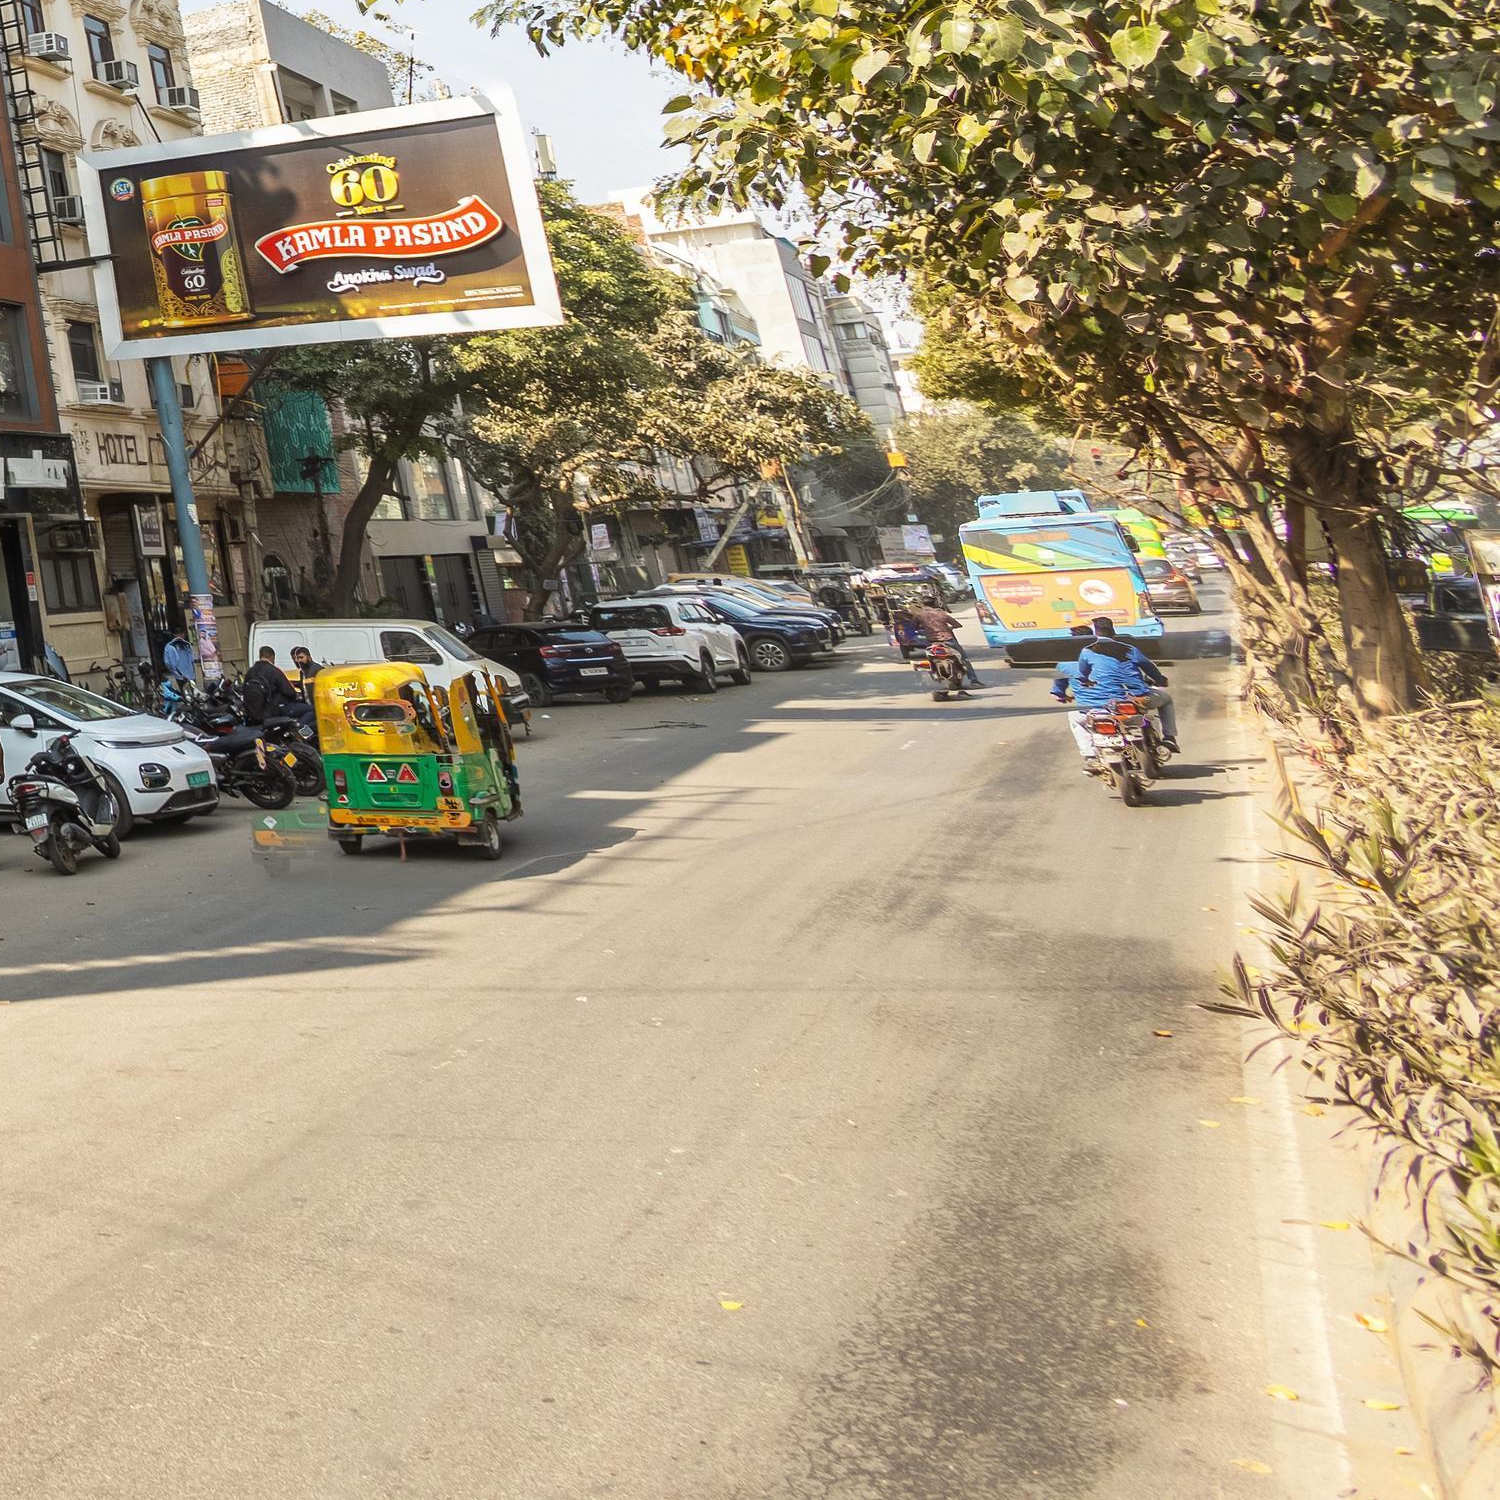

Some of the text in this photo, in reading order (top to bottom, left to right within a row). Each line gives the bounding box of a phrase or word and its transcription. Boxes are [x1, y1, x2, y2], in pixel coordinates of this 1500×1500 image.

[325, 152, 397, 174] Celebrating
[329, 164, 398, 207] 60
[353, 204, 385, 215] Years
[184, 222, 225, 240] PASAND
[274, 211, 487, 262] KAMLA PASAND
[184, 274, 206, 289] 60
[393, 262, 445, 287] Swad
[95, 431, 148, 466] HOTEL
